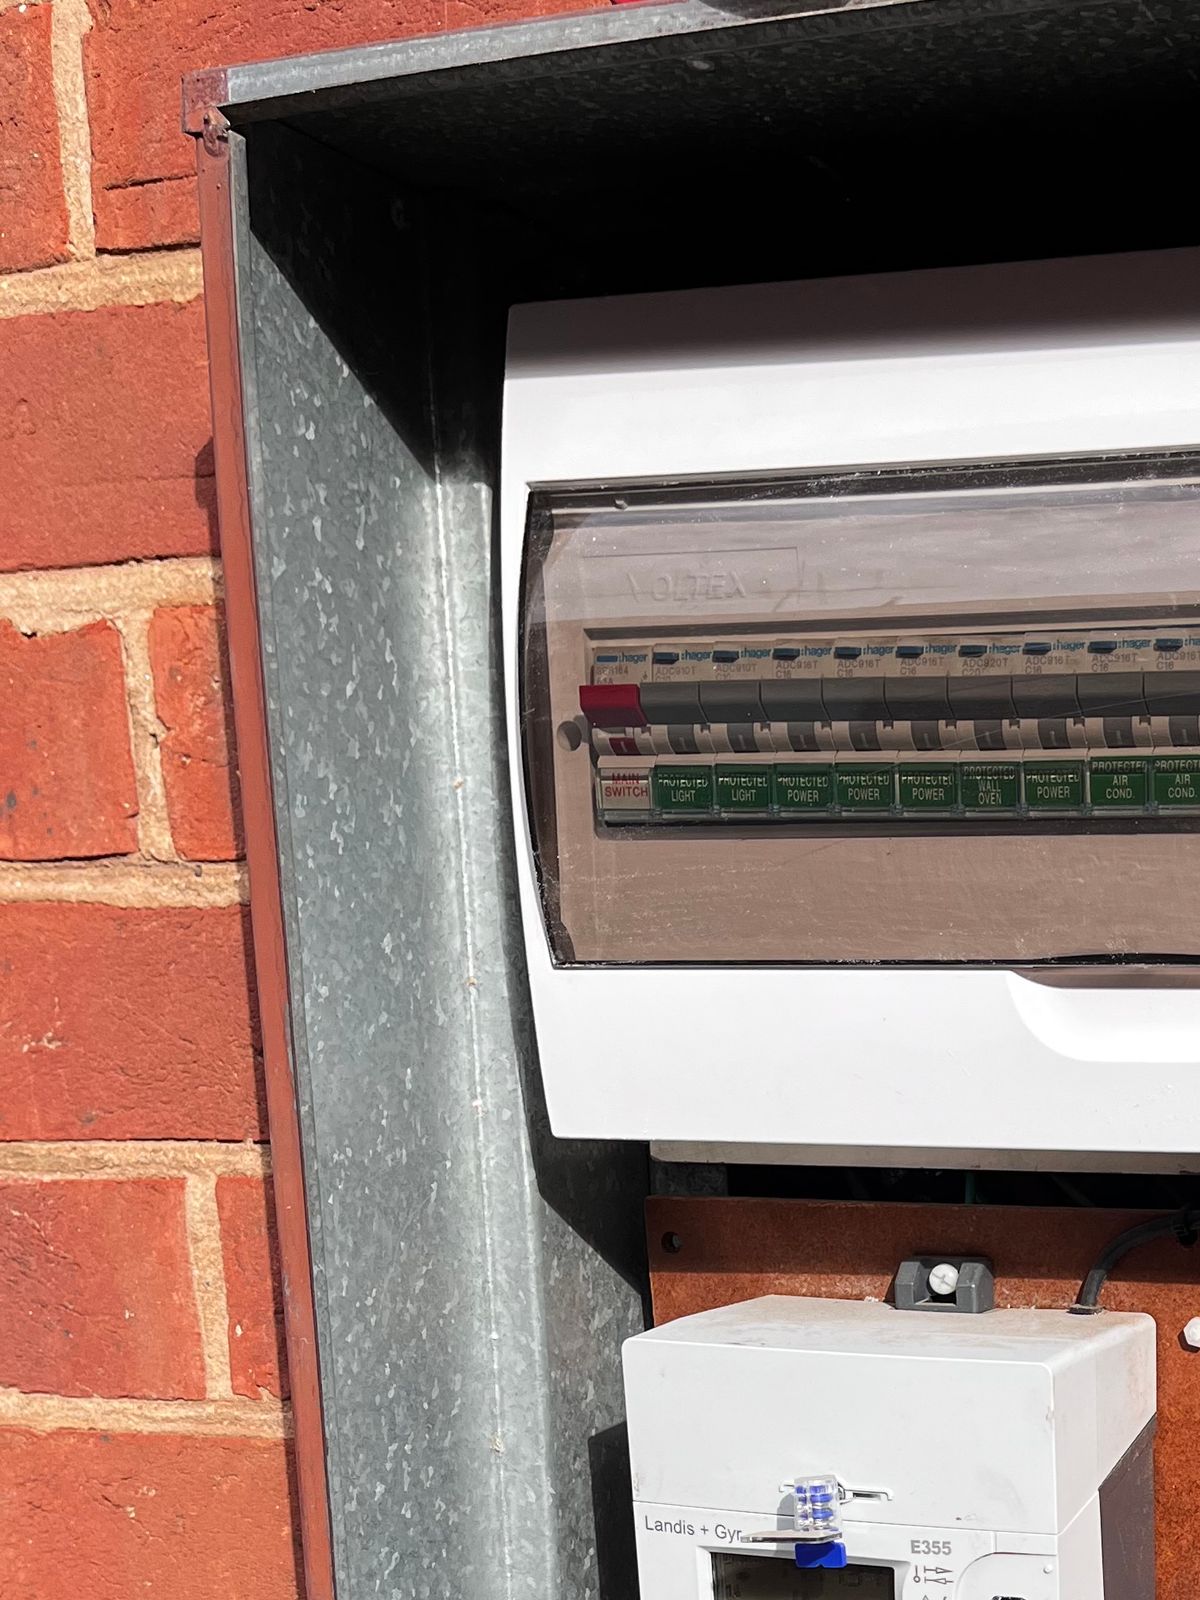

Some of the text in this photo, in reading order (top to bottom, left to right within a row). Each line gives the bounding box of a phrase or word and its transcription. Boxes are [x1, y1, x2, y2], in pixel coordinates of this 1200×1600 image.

[612, 773, 640, 785] MAIN
[1112, 774, 1129, 786] AIR
[1174, 773, 1191, 785] AIR
[605, 786, 649, 798] SWITCH
[978, 780, 1002, 792] WALL
[671, 790, 696, 802] LIGHT
[731, 789, 757, 802] LIGHT
[787, 789, 819, 802] POWER
[847, 788, 880, 801] POWER
[912, 788, 945, 801] POWER
[978, 792, 1002, 805] OVEN
[1036, 786, 1071, 799] POWER
[1105, 788, 1136, 799] COND.
[1167, 787, 1198, 798] COND.
[645, 1515, 695, 1536] Landis
[714, 1524, 742, 1544] Gyr
[911, 1539, 952, 1556] E355
